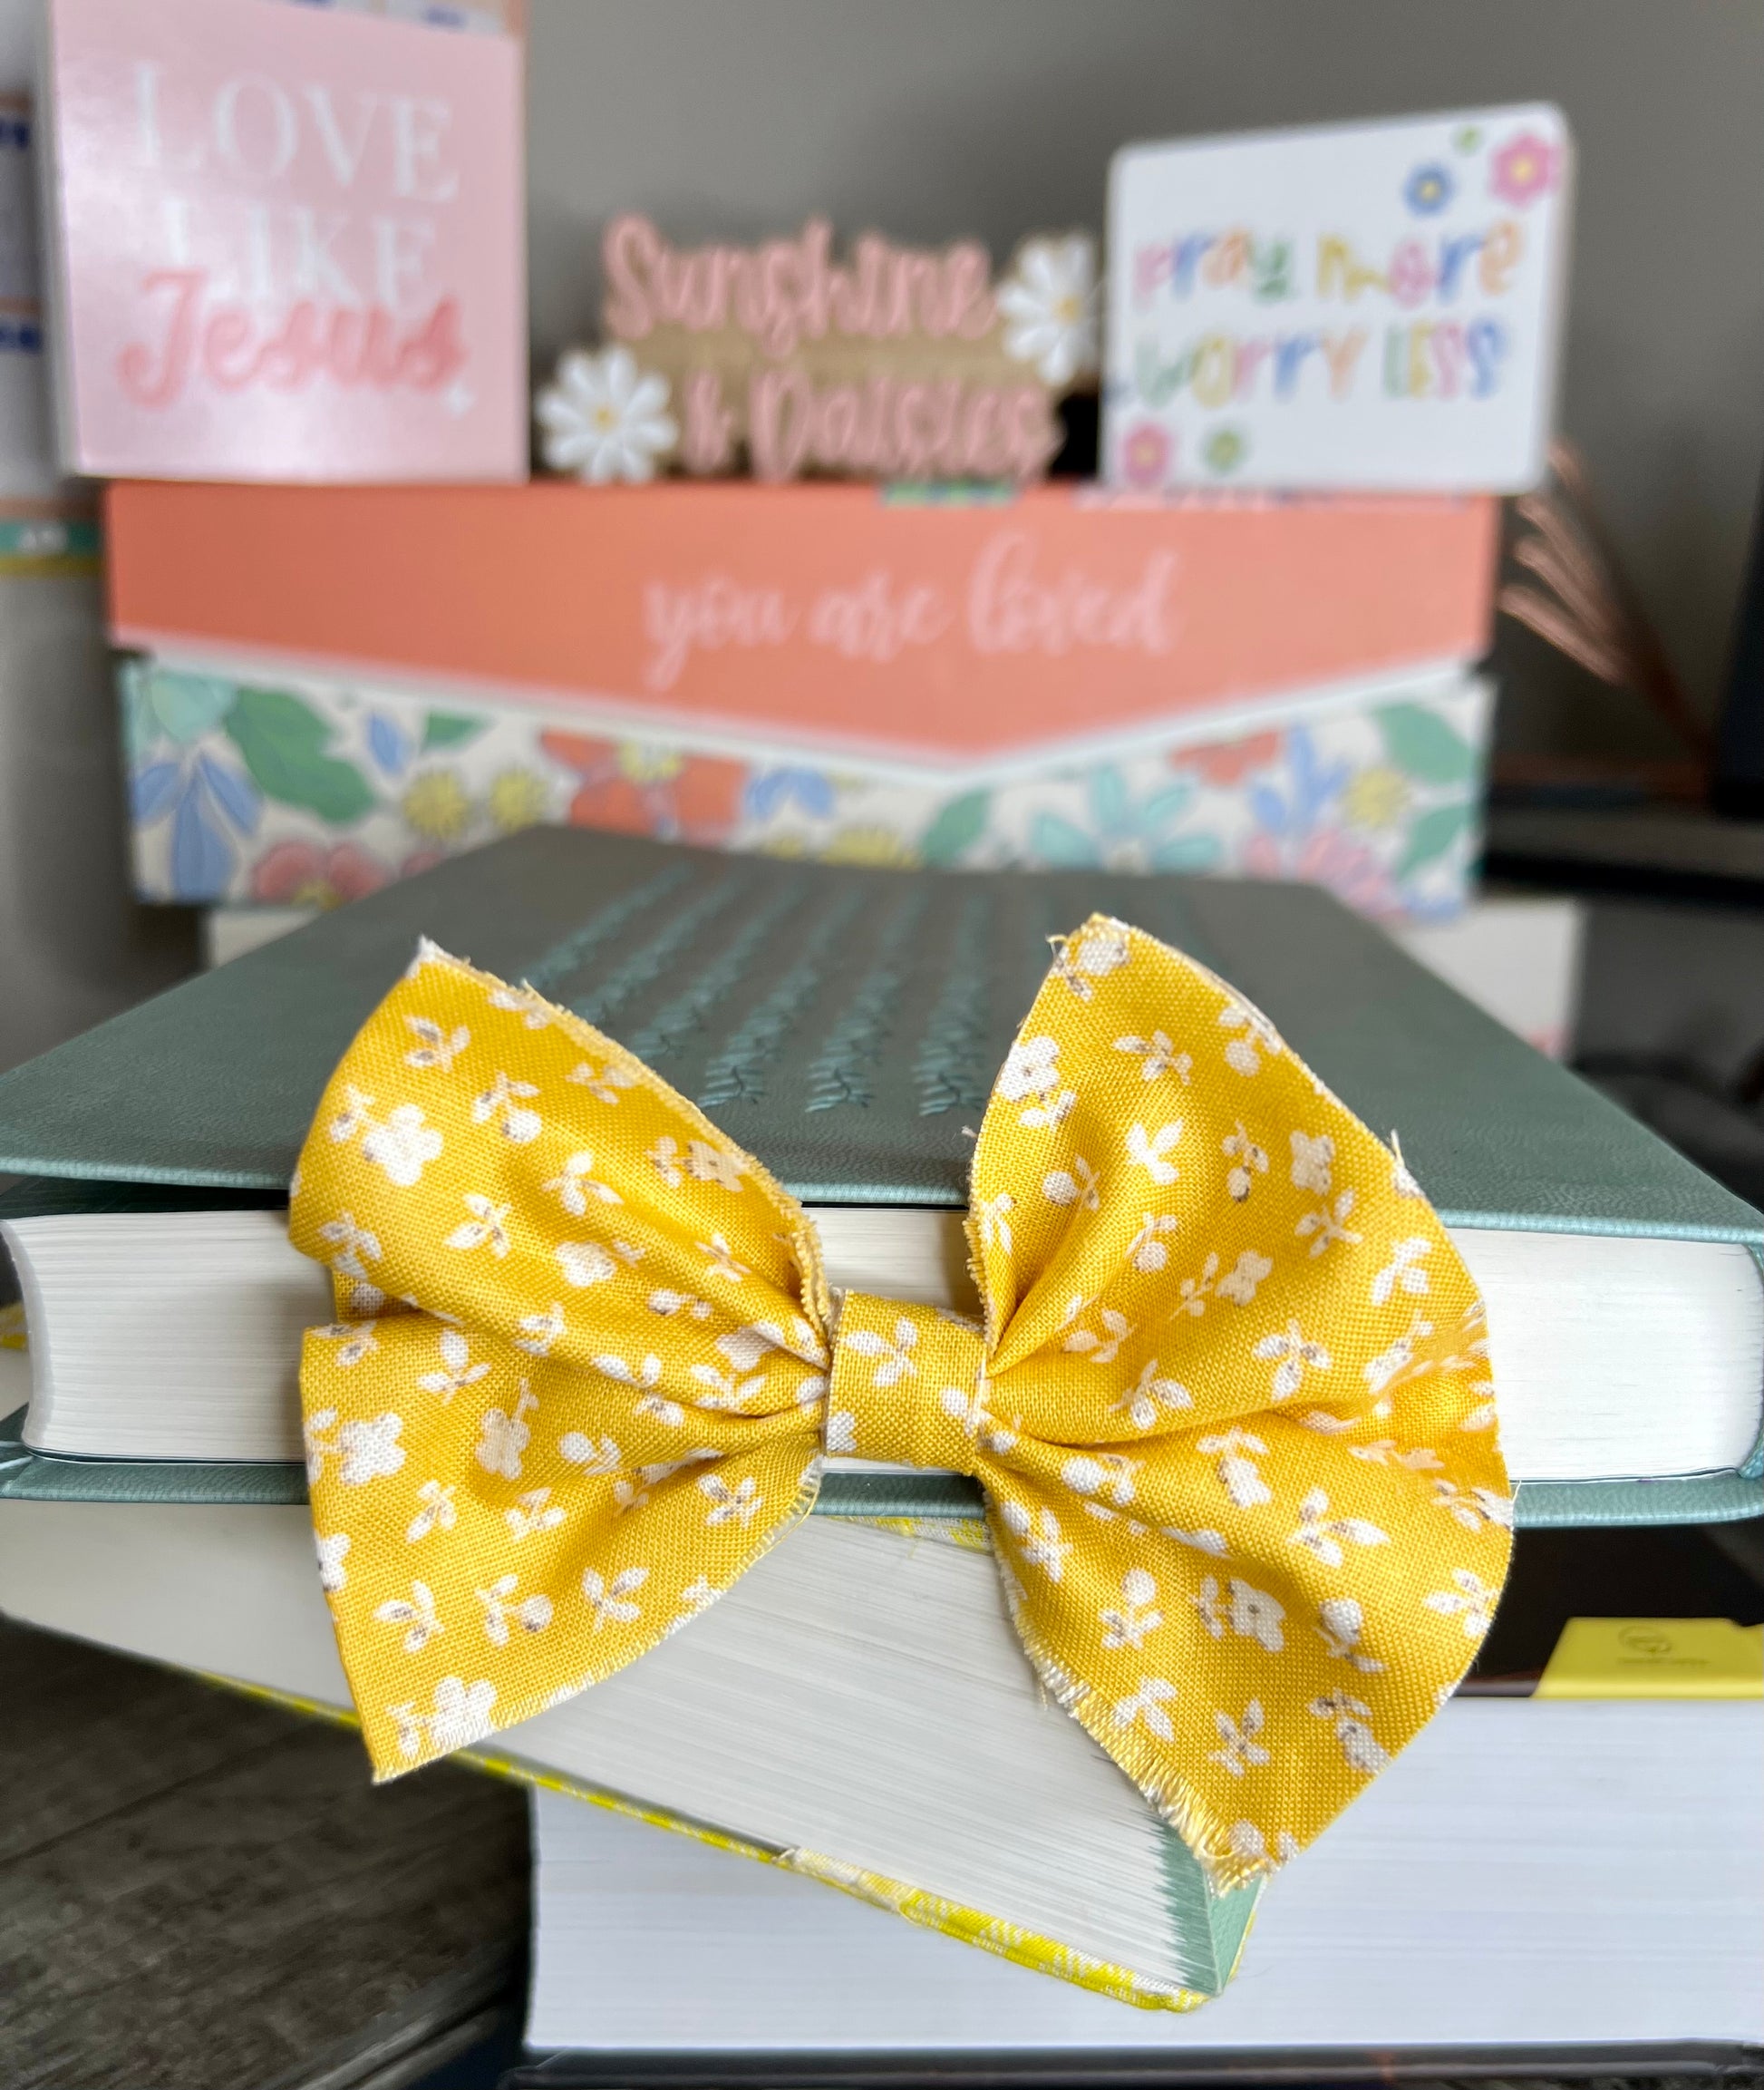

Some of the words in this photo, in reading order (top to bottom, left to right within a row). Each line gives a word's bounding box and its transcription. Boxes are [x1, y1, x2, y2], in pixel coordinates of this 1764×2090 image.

[132, 60, 460, 205] LOVE
[160, 196, 439, 306] LIKE
[602, 214, 1002, 358] Sunshine
[1314, 218, 1527, 308] more
[114, 267, 471, 412] Jesus
[643, 573, 796, 691] you
[810, 567, 950, 662] are
[967, 531, 1181, 655] loved
